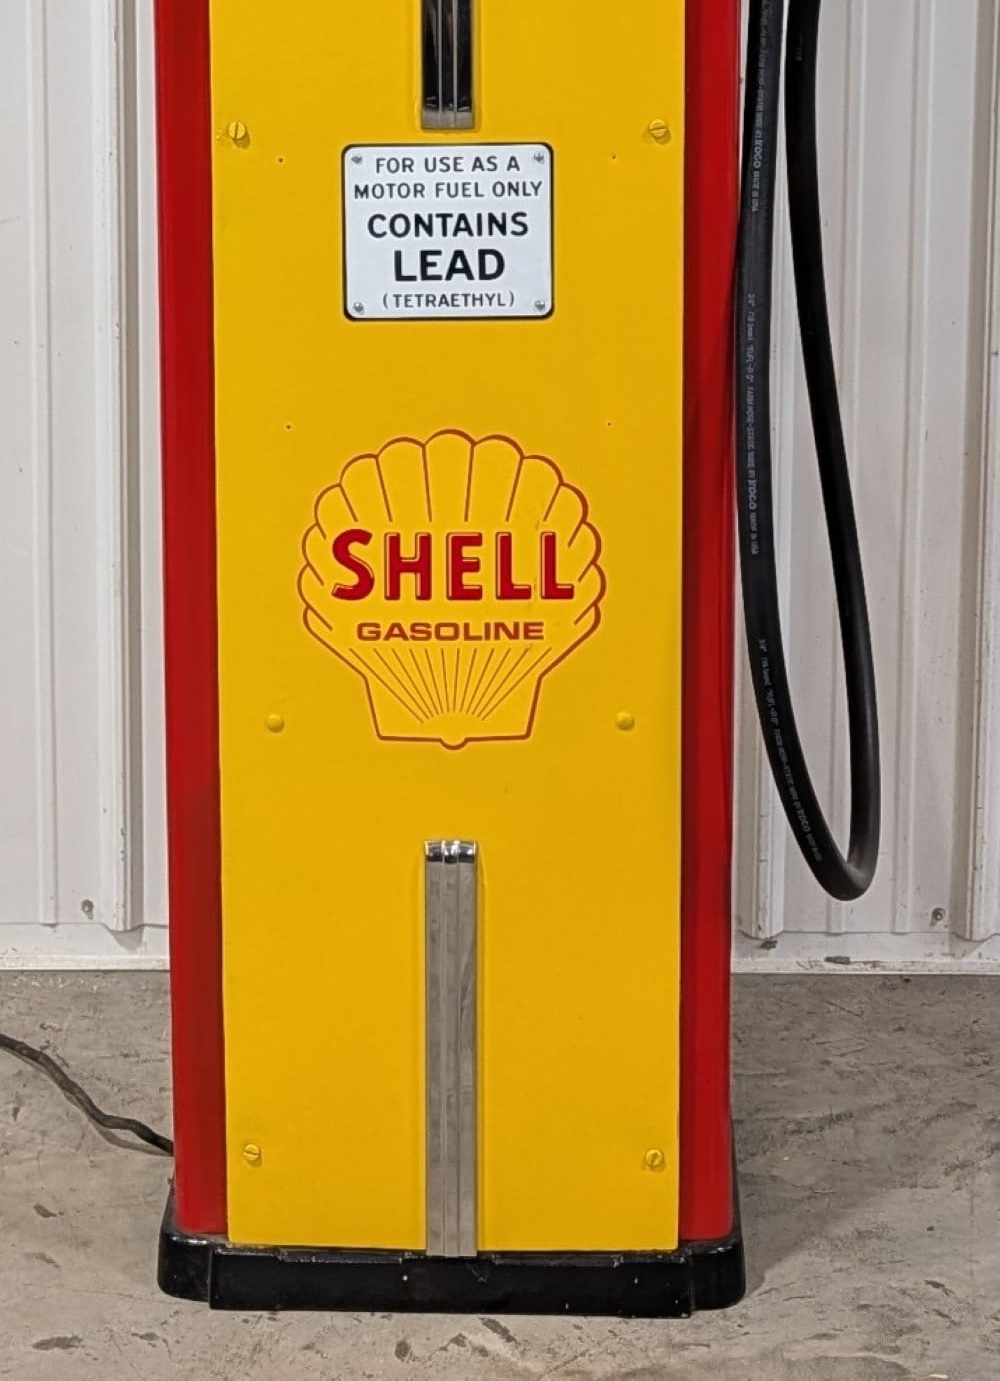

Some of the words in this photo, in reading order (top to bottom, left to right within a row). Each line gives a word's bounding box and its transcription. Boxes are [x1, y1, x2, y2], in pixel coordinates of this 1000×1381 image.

[375, 157, 415, 174] FOR
[424, 156, 464, 173] USE
[471, 155, 499, 172] AS
[506, 155, 521, 172] A
[354, 182, 426, 199] MOTOR
[435, 182, 485, 198] FUEL
[492, 180, 543, 197] ONLY
[367, 211, 529, 239] CONTAINS
[393, 248, 506, 282] LEAD
[382, 290, 515, 309] (TETRAETHYL)
[331, 528, 575, 601] SHELL
[357, 621, 545, 642] GASOLINE
